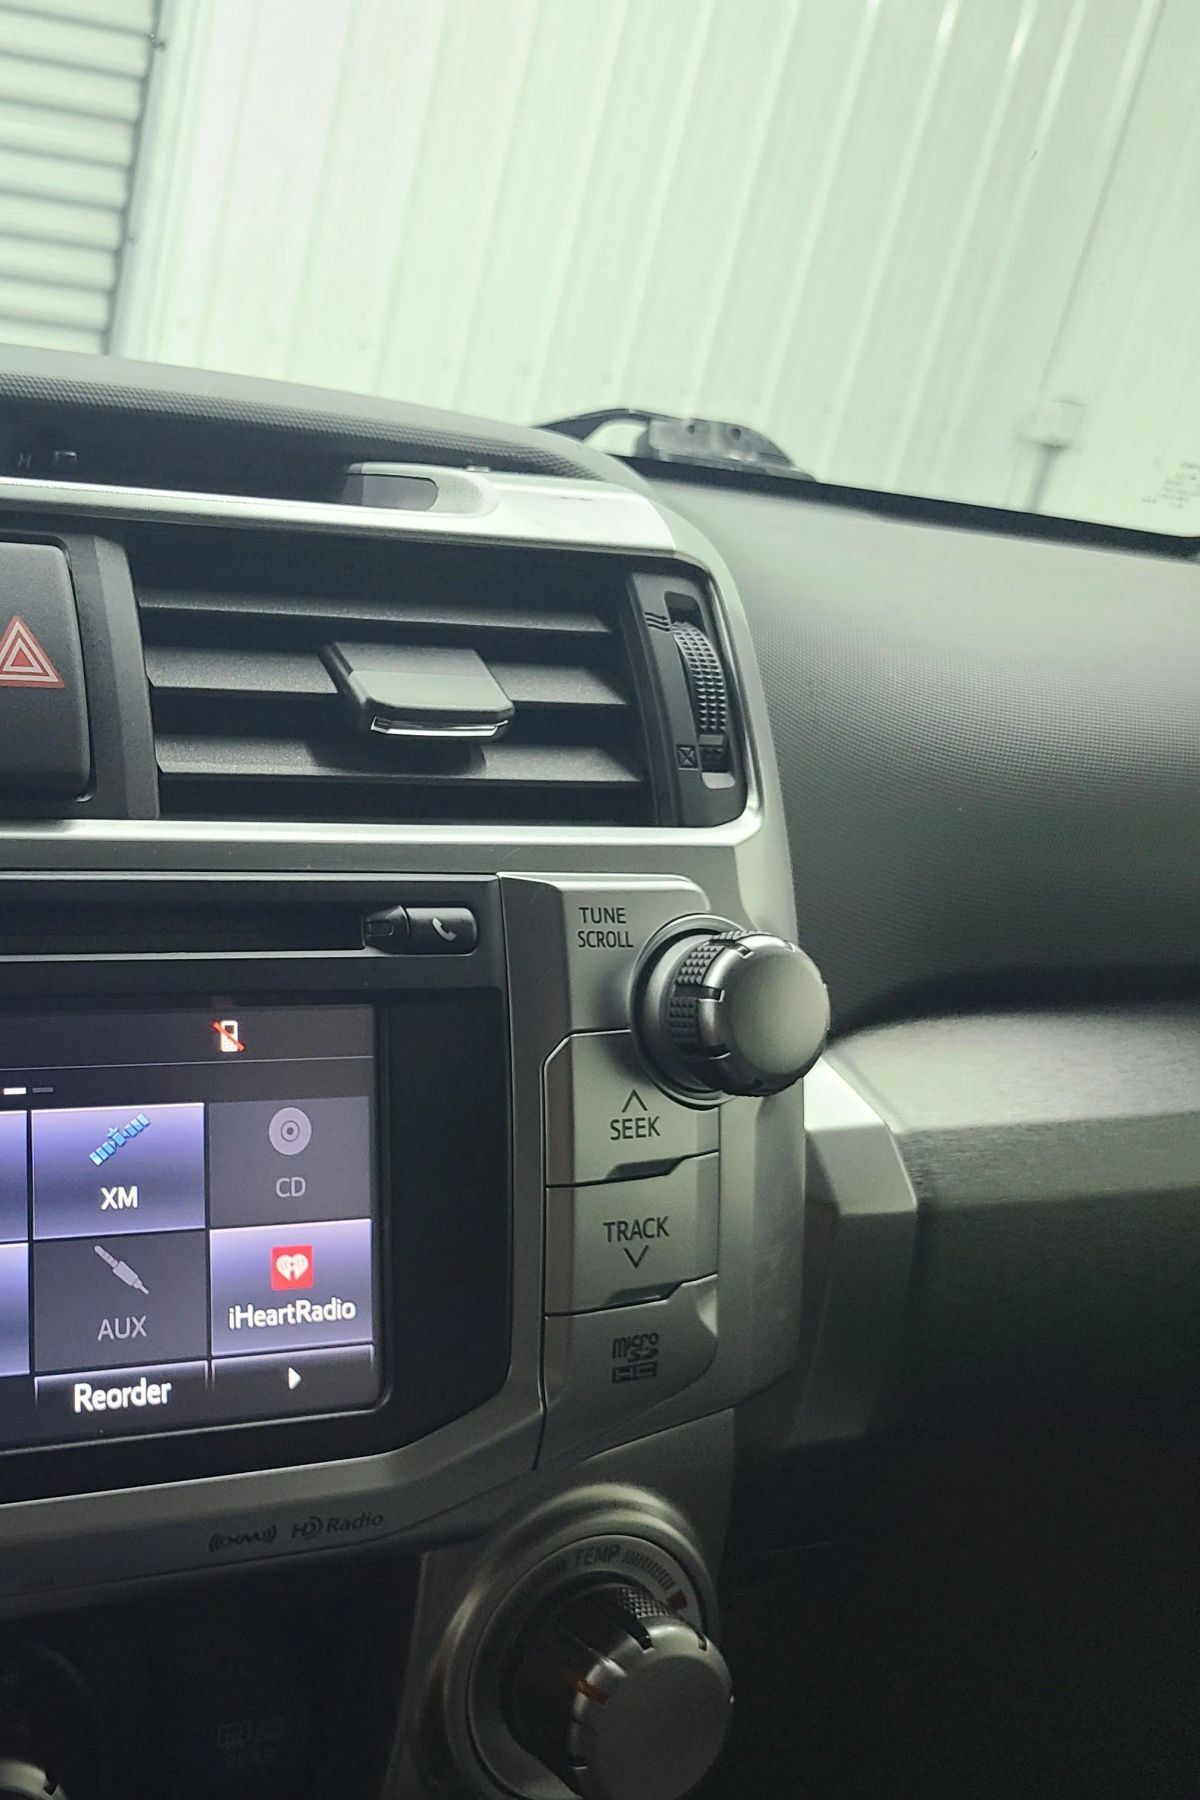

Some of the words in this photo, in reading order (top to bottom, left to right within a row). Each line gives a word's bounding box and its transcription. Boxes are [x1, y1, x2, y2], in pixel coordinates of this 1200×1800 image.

[578, 906, 627, 925] TUNE
[577, 930, 634, 948] SCROLL
[610, 1116, 660, 1140] SEEK
[100, 1186, 140, 1211] XM
[275, 1176, 308, 1199] CD
[603, 1216, 669, 1243] TRACK
[227, 1297, 357, 1330] iHeartRadio
[97, 1316, 148, 1341] AUX
[611, 1332, 659, 1359] micro
[72, 1377, 172, 1412] Reorder
[326, 1512, 384, 1534] Radio
[575, 1544, 621, 1567] TEMP
